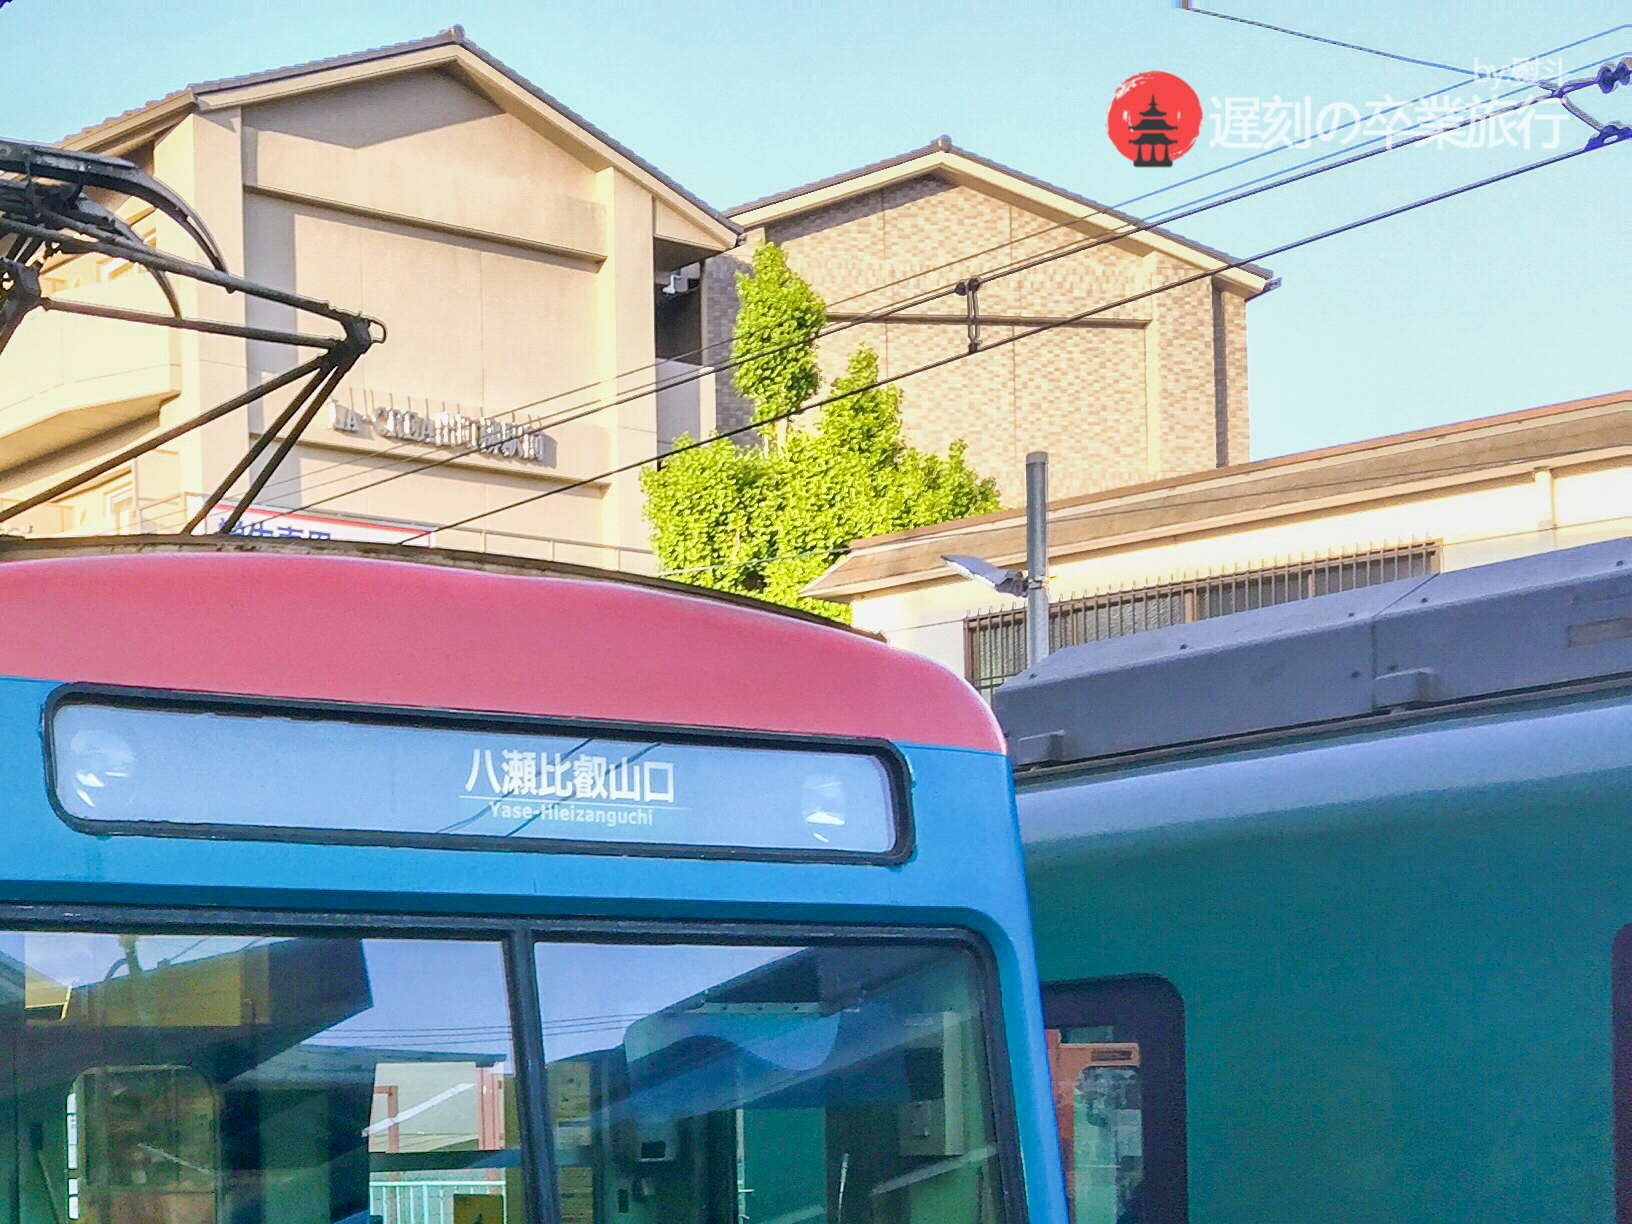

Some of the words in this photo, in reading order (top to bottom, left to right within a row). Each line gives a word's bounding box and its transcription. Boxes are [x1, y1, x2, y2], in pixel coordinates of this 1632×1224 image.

[465, 748, 675, 803] 八瀬比叡山口
[489, 801, 653, 827] Yase-Hieizanguchi
